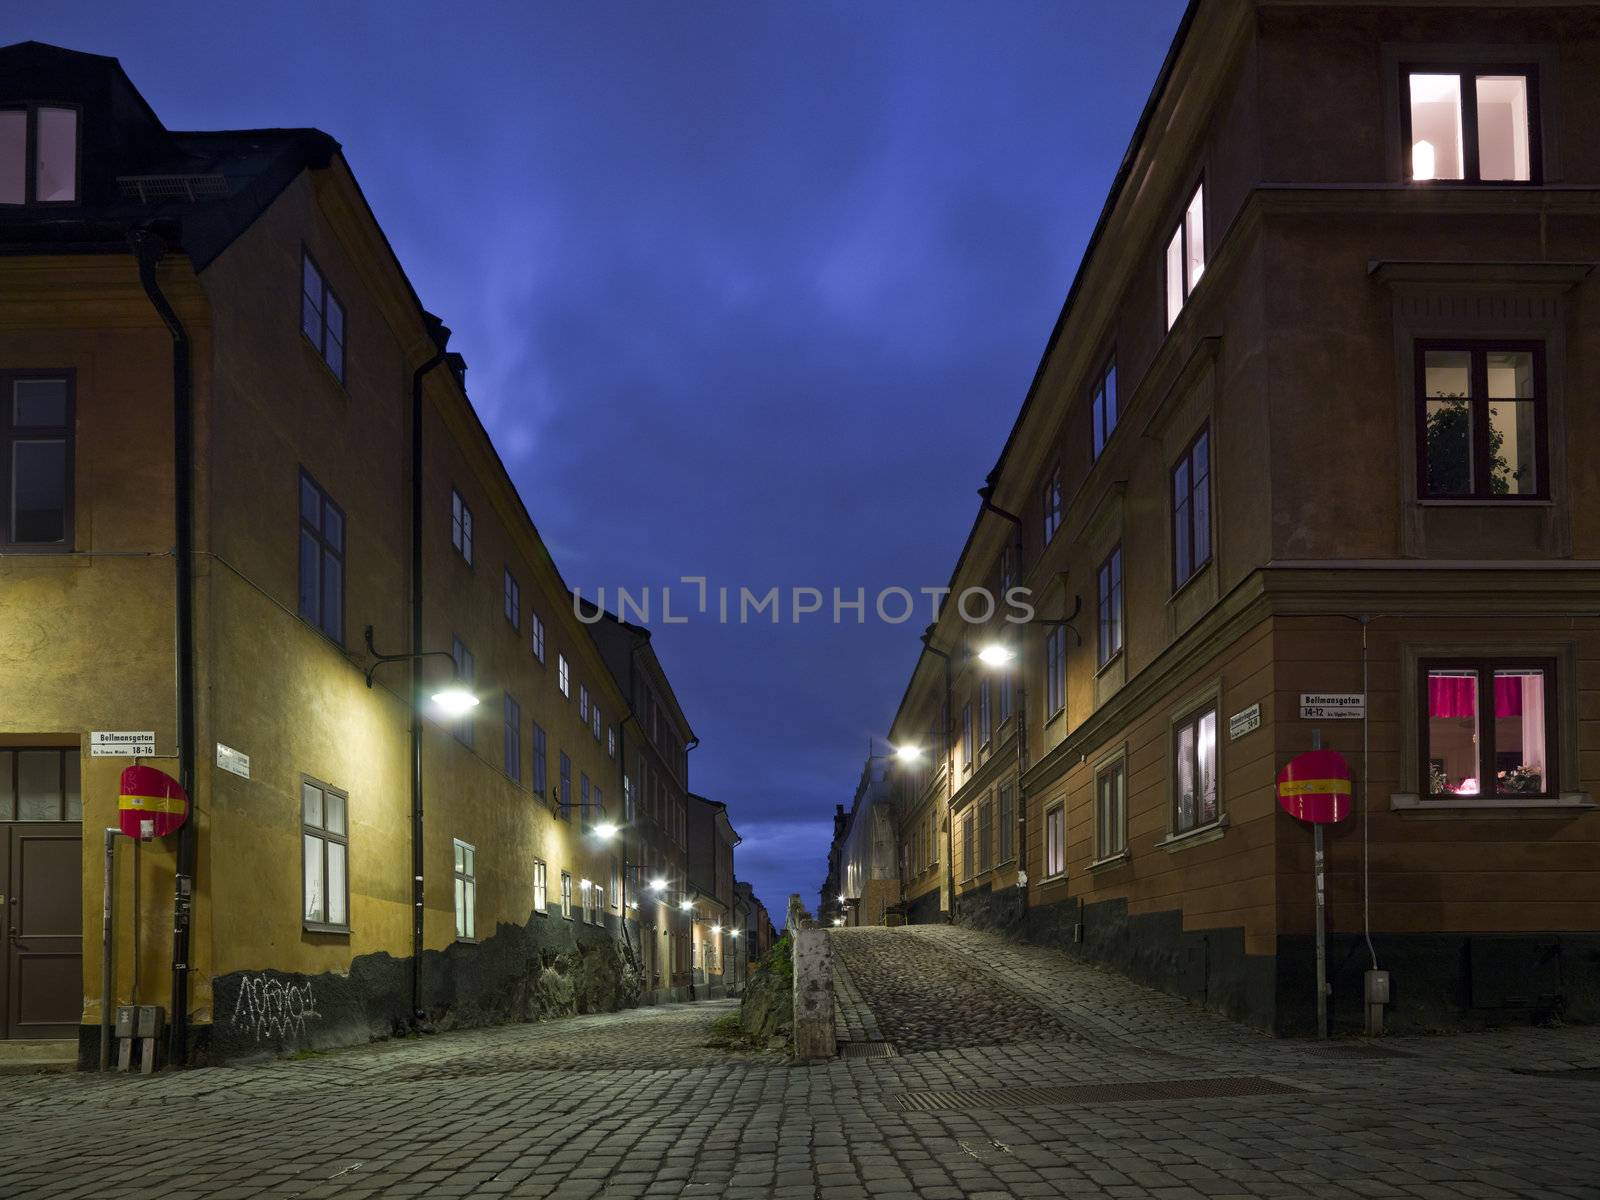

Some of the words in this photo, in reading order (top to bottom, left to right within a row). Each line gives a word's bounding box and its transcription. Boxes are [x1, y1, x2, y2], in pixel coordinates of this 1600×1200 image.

[1305, 696, 1360, 705] Bellmansgatan
[1304, 708, 1324, 717] 14-12
[100, 734, 153, 743] Bellmansgatan
[132, 746, 153, 754] 18-16
